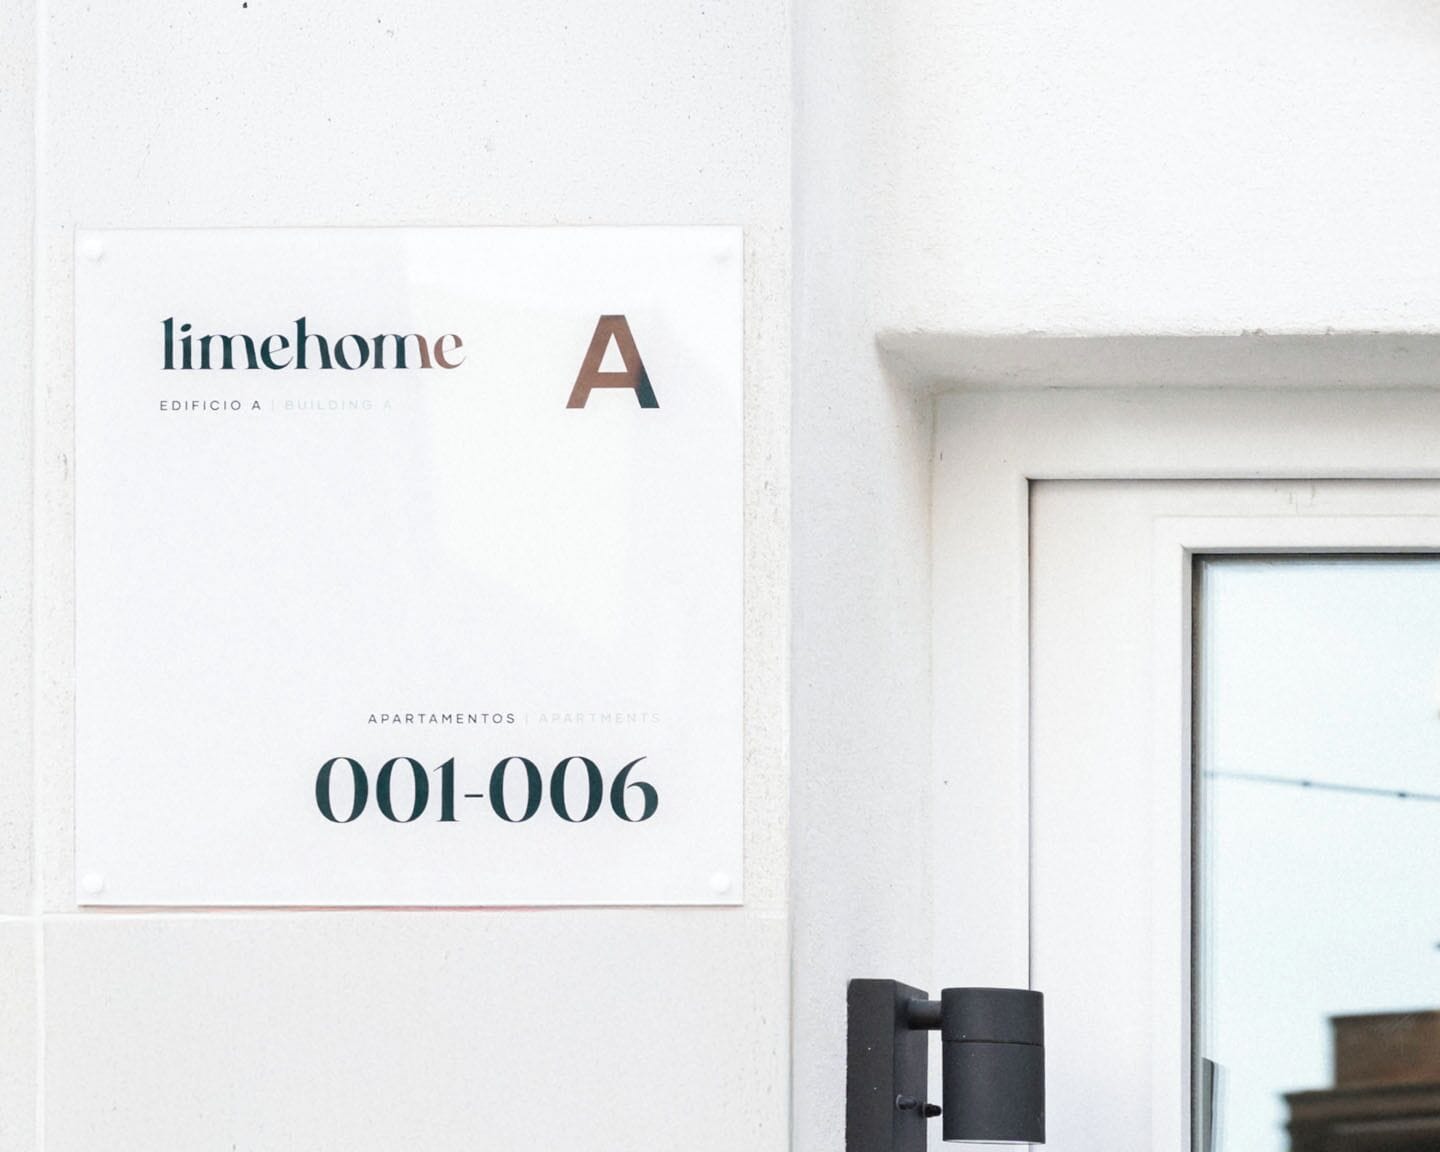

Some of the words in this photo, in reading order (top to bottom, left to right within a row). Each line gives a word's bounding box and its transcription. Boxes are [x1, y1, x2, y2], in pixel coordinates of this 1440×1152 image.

[161, 317, 465, 370] limehome
[566, 315, 660, 409] A
[160, 400, 242, 411] EDIFICIO
[251, 400, 262, 411] A
[284, 400, 373, 411] BUILDING
[368, 713, 515, 724] APARTAMENTOS
[539, 713, 661, 724] APARTMENTS
[315, 756, 660, 823] 001-006
